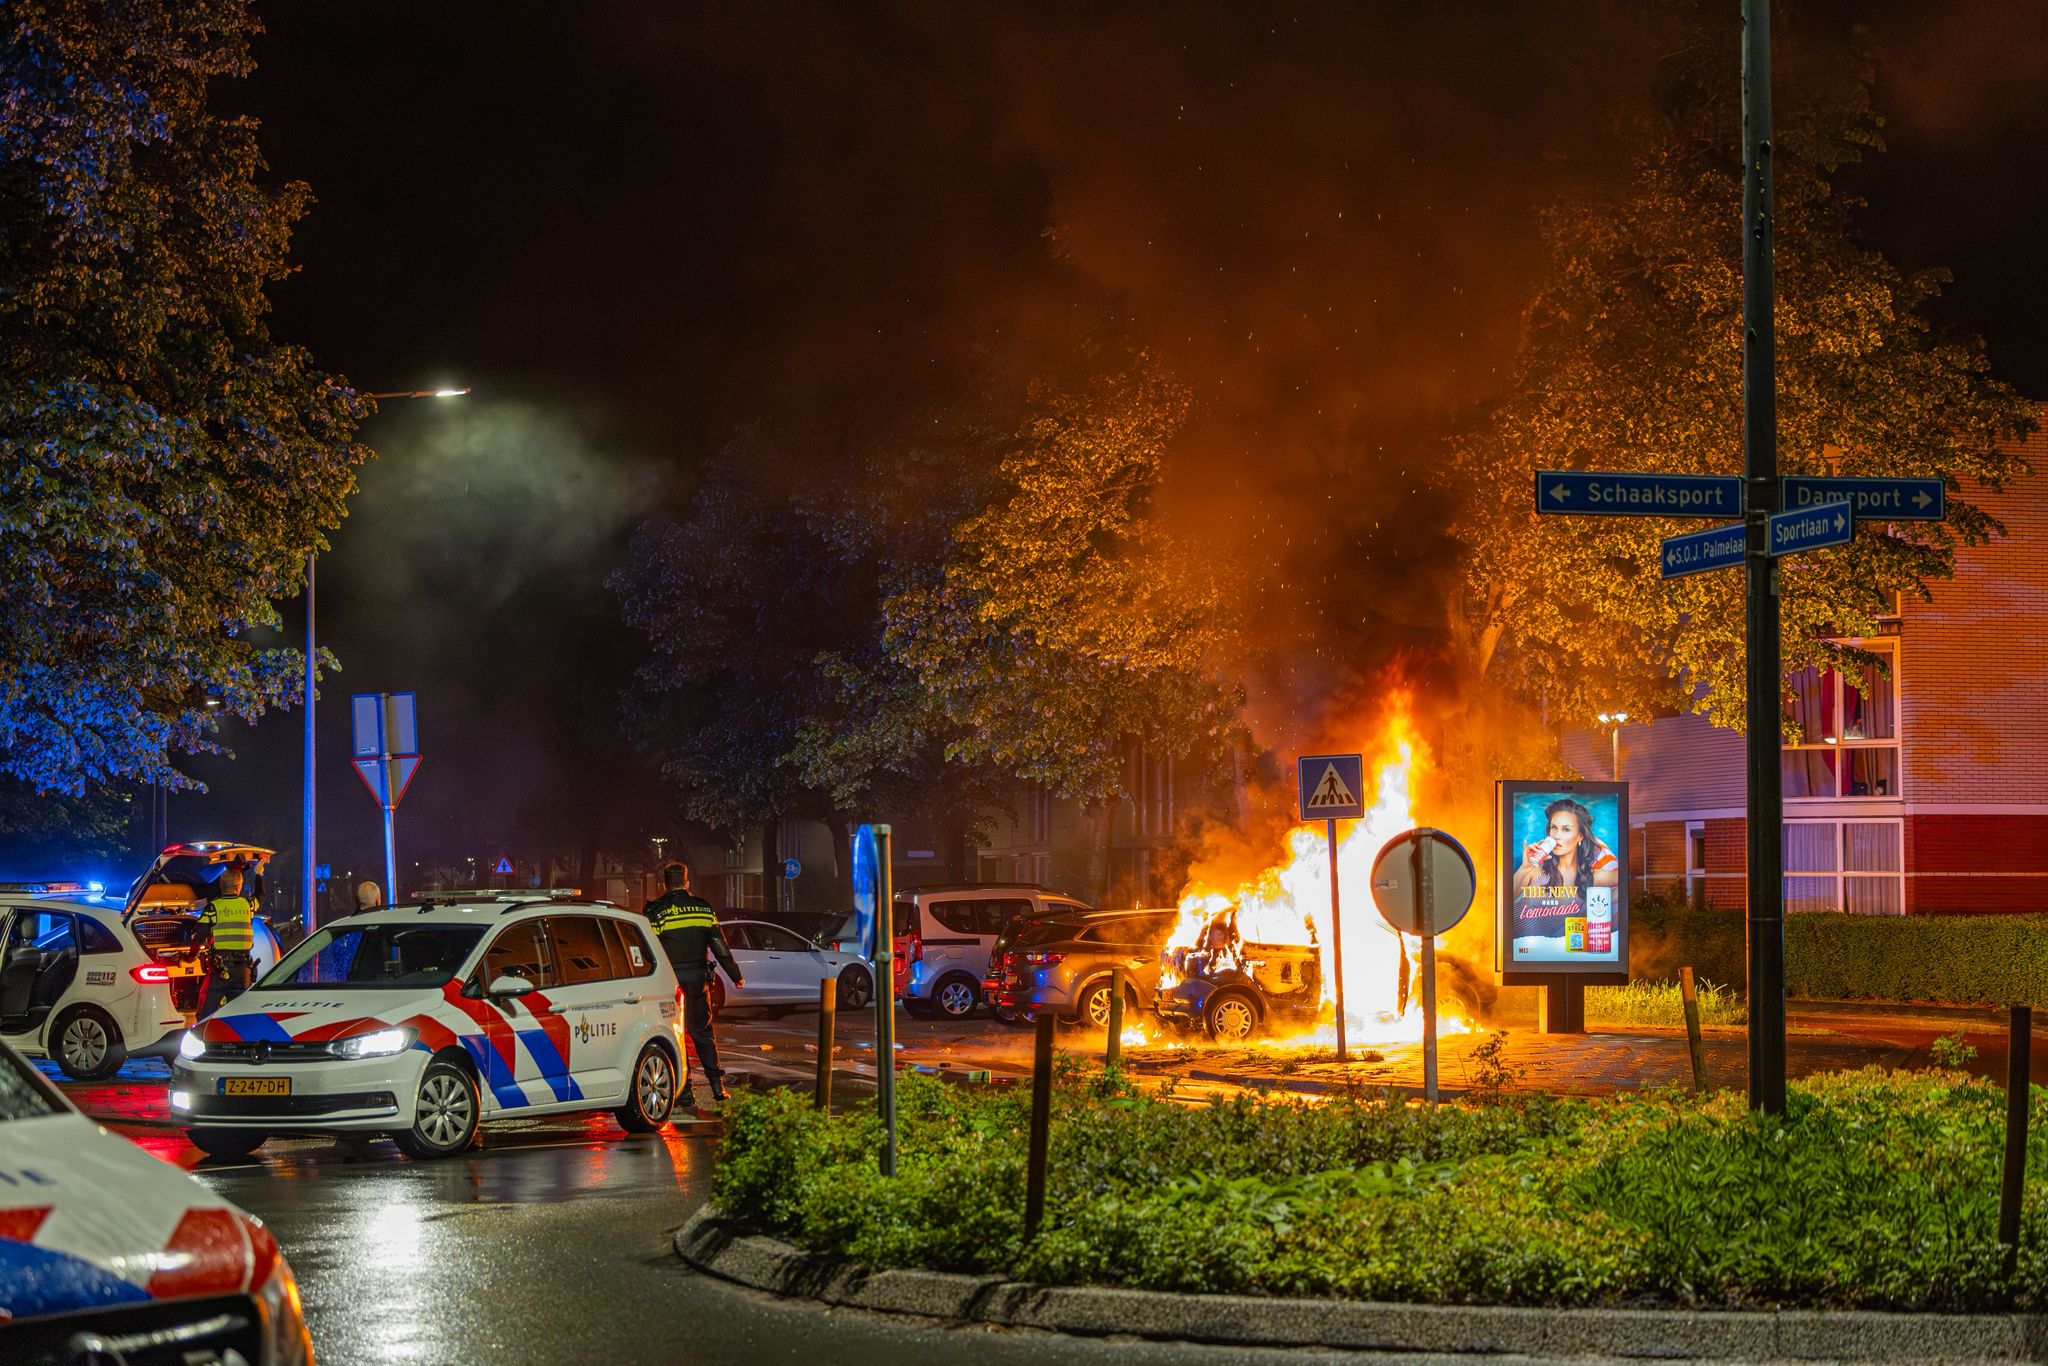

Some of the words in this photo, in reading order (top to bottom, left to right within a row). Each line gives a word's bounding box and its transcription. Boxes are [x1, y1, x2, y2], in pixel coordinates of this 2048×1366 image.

[1587, 482, 1723, 508] Schaaksport
[1775, 518, 1829, 545] Sportlaan
[1675, 543, 1701, 565] S.O.J.
[1521, 885, 1548, 898] THE
[1548, 885, 1578, 898] NEW
[1520, 900, 1580, 919] Lemonade
[102, 971, 116, 980] 112
[260, 1001, 345, 1009] POLITIE
[575, 1018, 617, 1043] POLITIE
[228, 1079, 286, 1094] Z-247-DH
